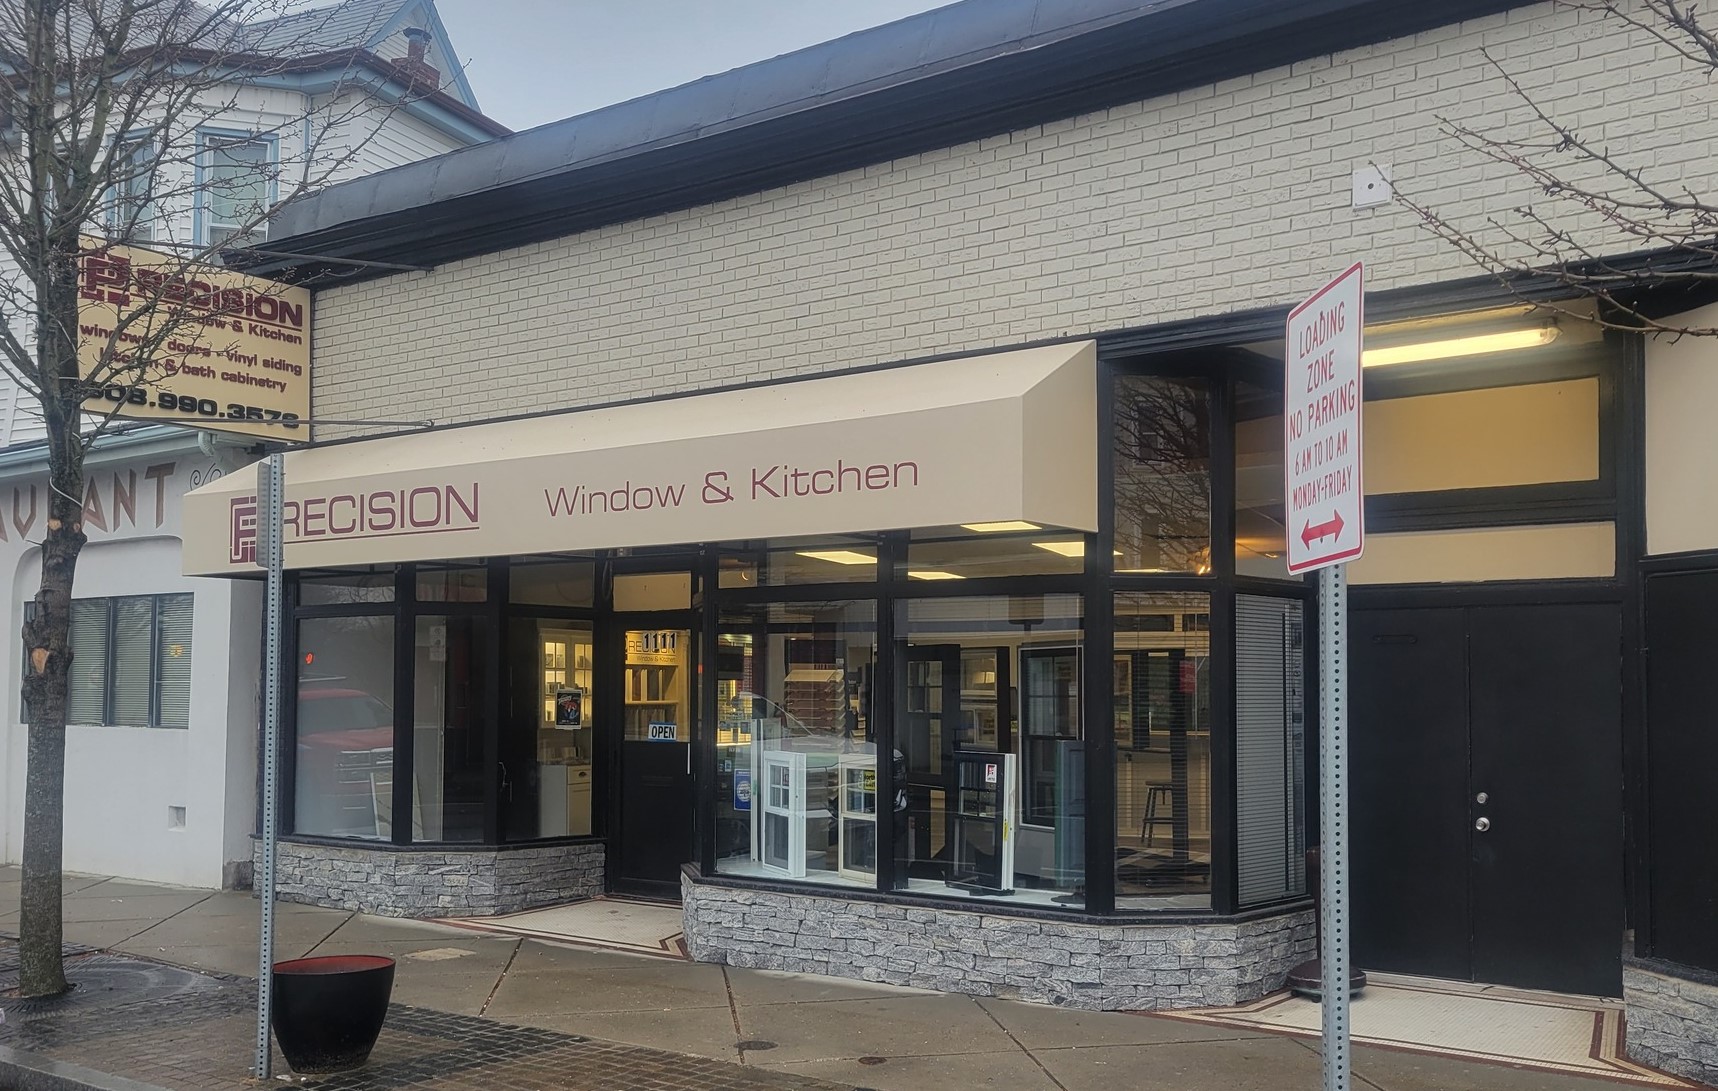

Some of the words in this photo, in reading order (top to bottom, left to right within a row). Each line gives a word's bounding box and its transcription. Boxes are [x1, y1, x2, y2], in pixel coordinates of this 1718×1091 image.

[232, 319, 244, 333] &
[248, 322, 302, 345] Kitchen
[1299, 301, 1345, 359] LOADING
[165, 358, 178, 372] &
[181, 361, 216, 379] bath
[220, 370, 287, 393] cabinetry
[226, 350, 258, 367] vinyl
[262, 358, 302, 376] siding
[1306, 348, 1335, 394] ZONE
[1289, 408, 1303, 442] NO
[1307, 379, 1356, 433] PARKING
[1295, 452, 1300, 476] 6
[1301, 446, 1312, 474] AM
[1314, 440, 1323, 468] TO
[1325, 435, 1334, 462] 10
[1336, 427, 1348, 458] AM
[0, 461, 176, 543] UANT
[544, 481, 686, 517] Window
[701, 471, 734, 504] &
[751, 460, 919, 500] Kitchen
[1292, 464, 1352, 512] MONDAY-FRIDAY
[644, 632, 676, 650] 1111
[651, 725, 675, 739] OPEN
